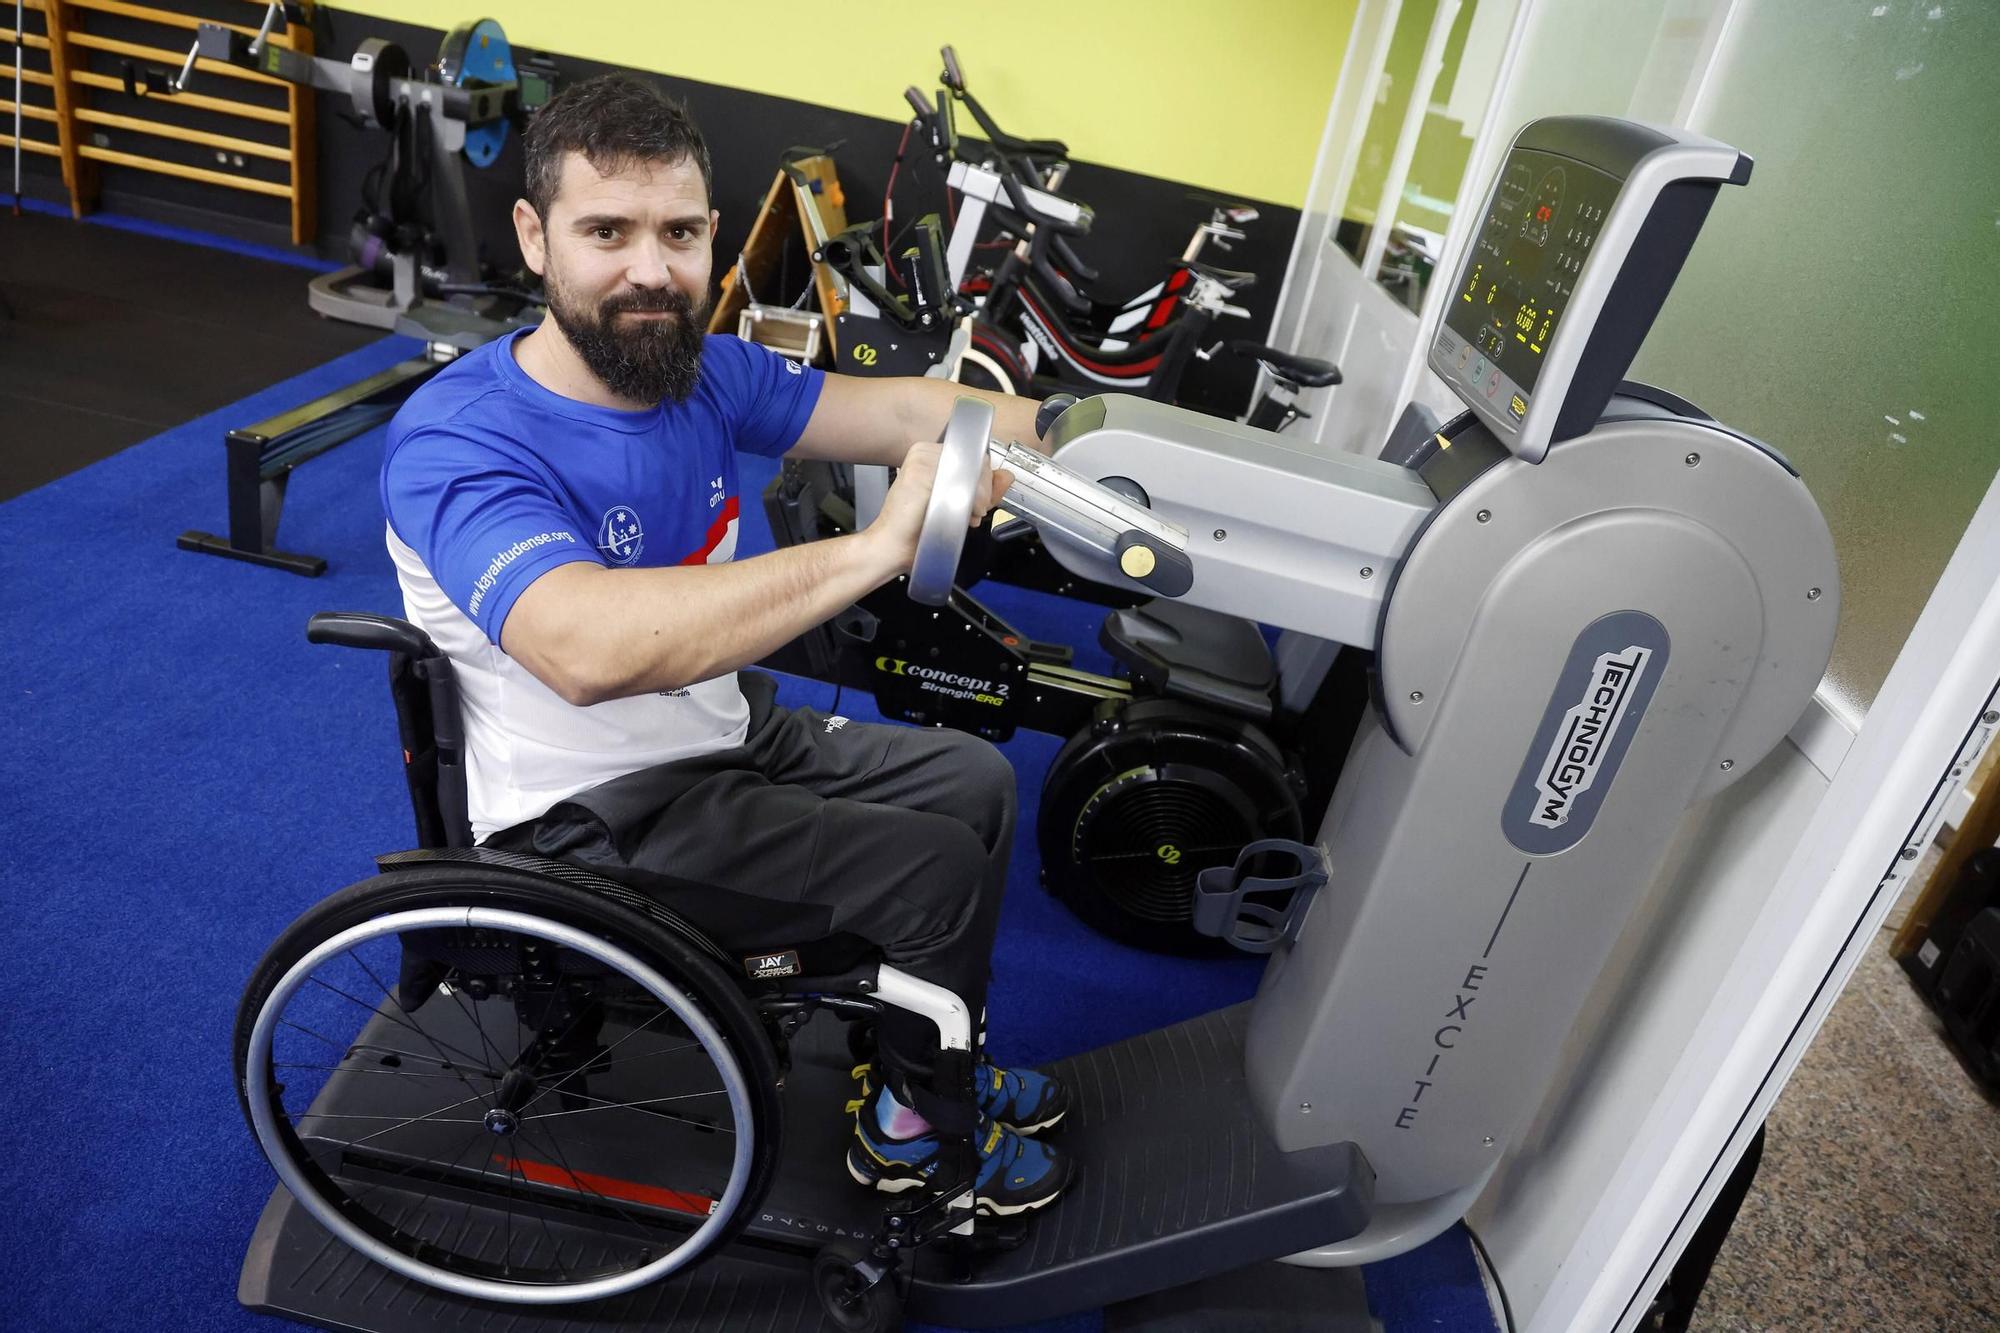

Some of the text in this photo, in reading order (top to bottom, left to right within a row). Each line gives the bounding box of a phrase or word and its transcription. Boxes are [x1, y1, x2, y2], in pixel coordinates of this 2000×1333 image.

[468, 529, 576, 617] www.kayaktudense.org
[907, 665, 1009, 696] concept 2
[920, 681, 1004, 707] StrengthERG
[759, 955, 785, 969] JAY
[1394, 964, 1489, 1130] EXCITE
